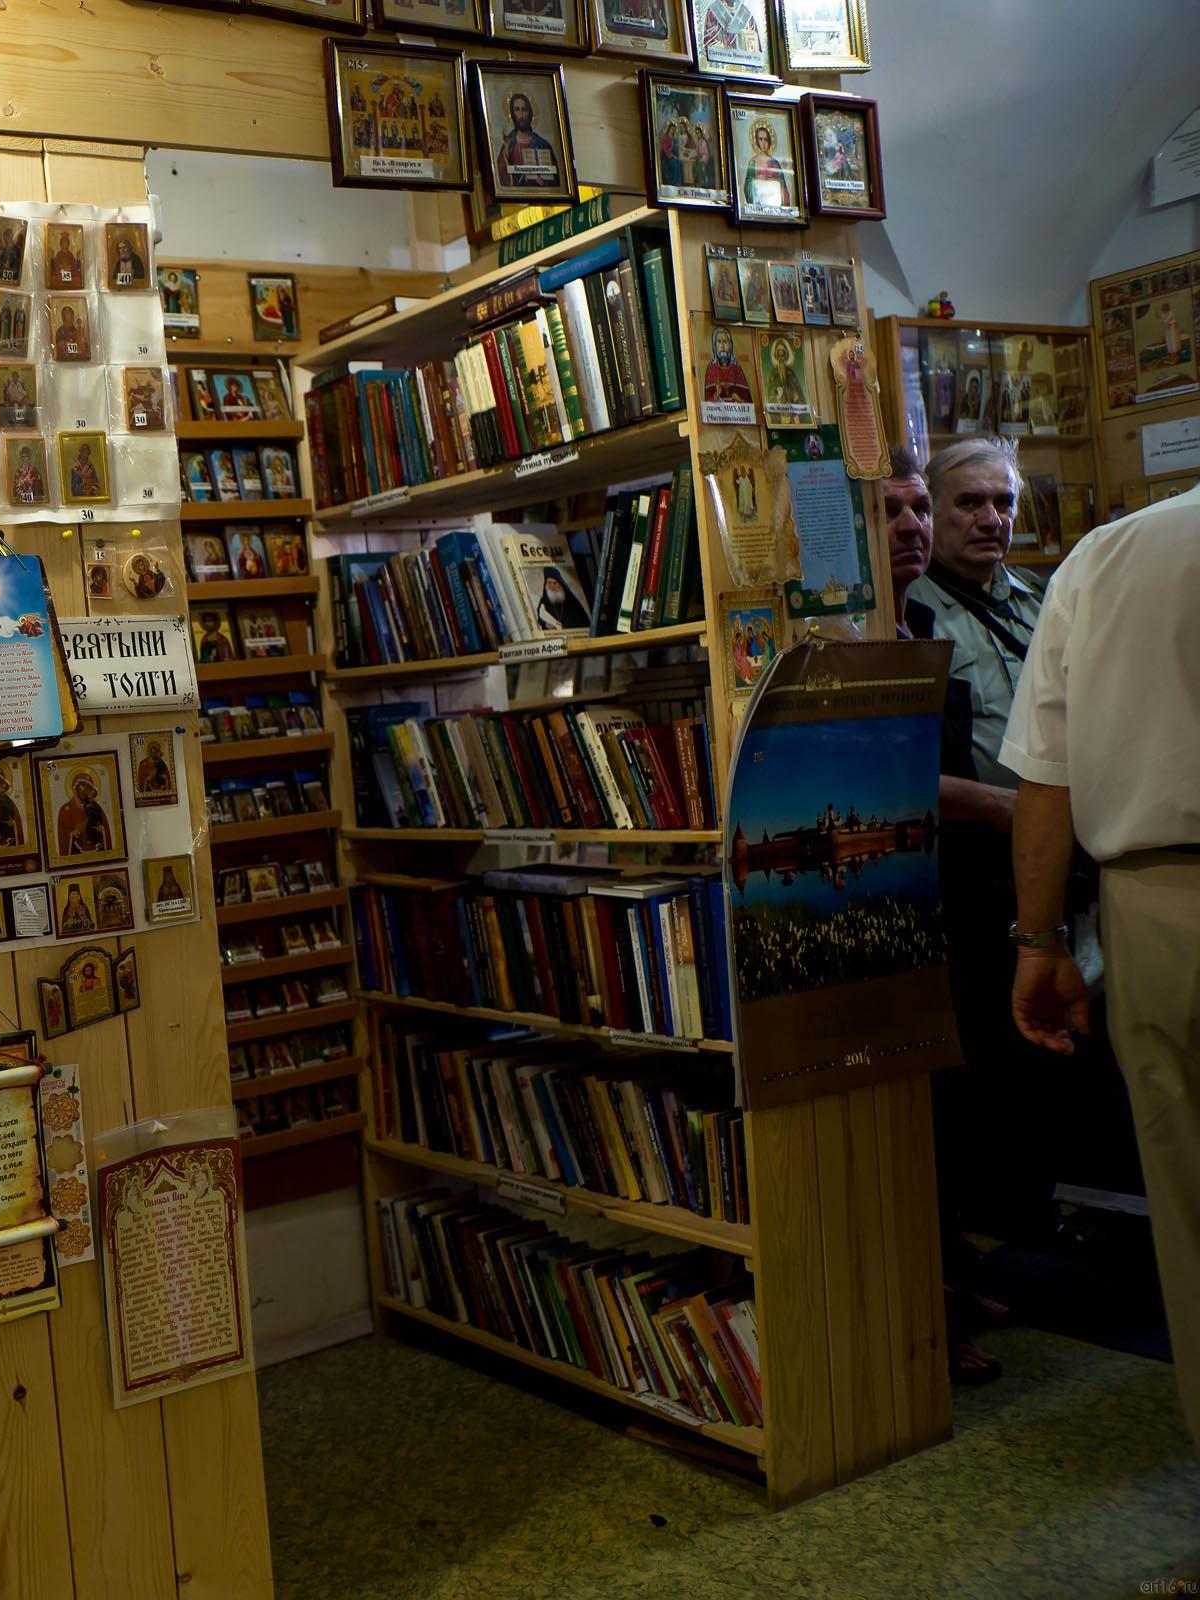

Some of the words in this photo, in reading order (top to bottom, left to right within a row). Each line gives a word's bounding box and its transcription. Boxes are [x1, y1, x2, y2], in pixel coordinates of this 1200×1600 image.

[137, 346, 148, 355] 30
[76, 420, 86, 428] 30
[135, 415, 145, 424] 30
[142, 489, 152, 498] 30
[81, 509, 94, 520] 30
[103, 669, 178, 699] ТОЛГИ
[844, 1040, 871, 1066] 2014
